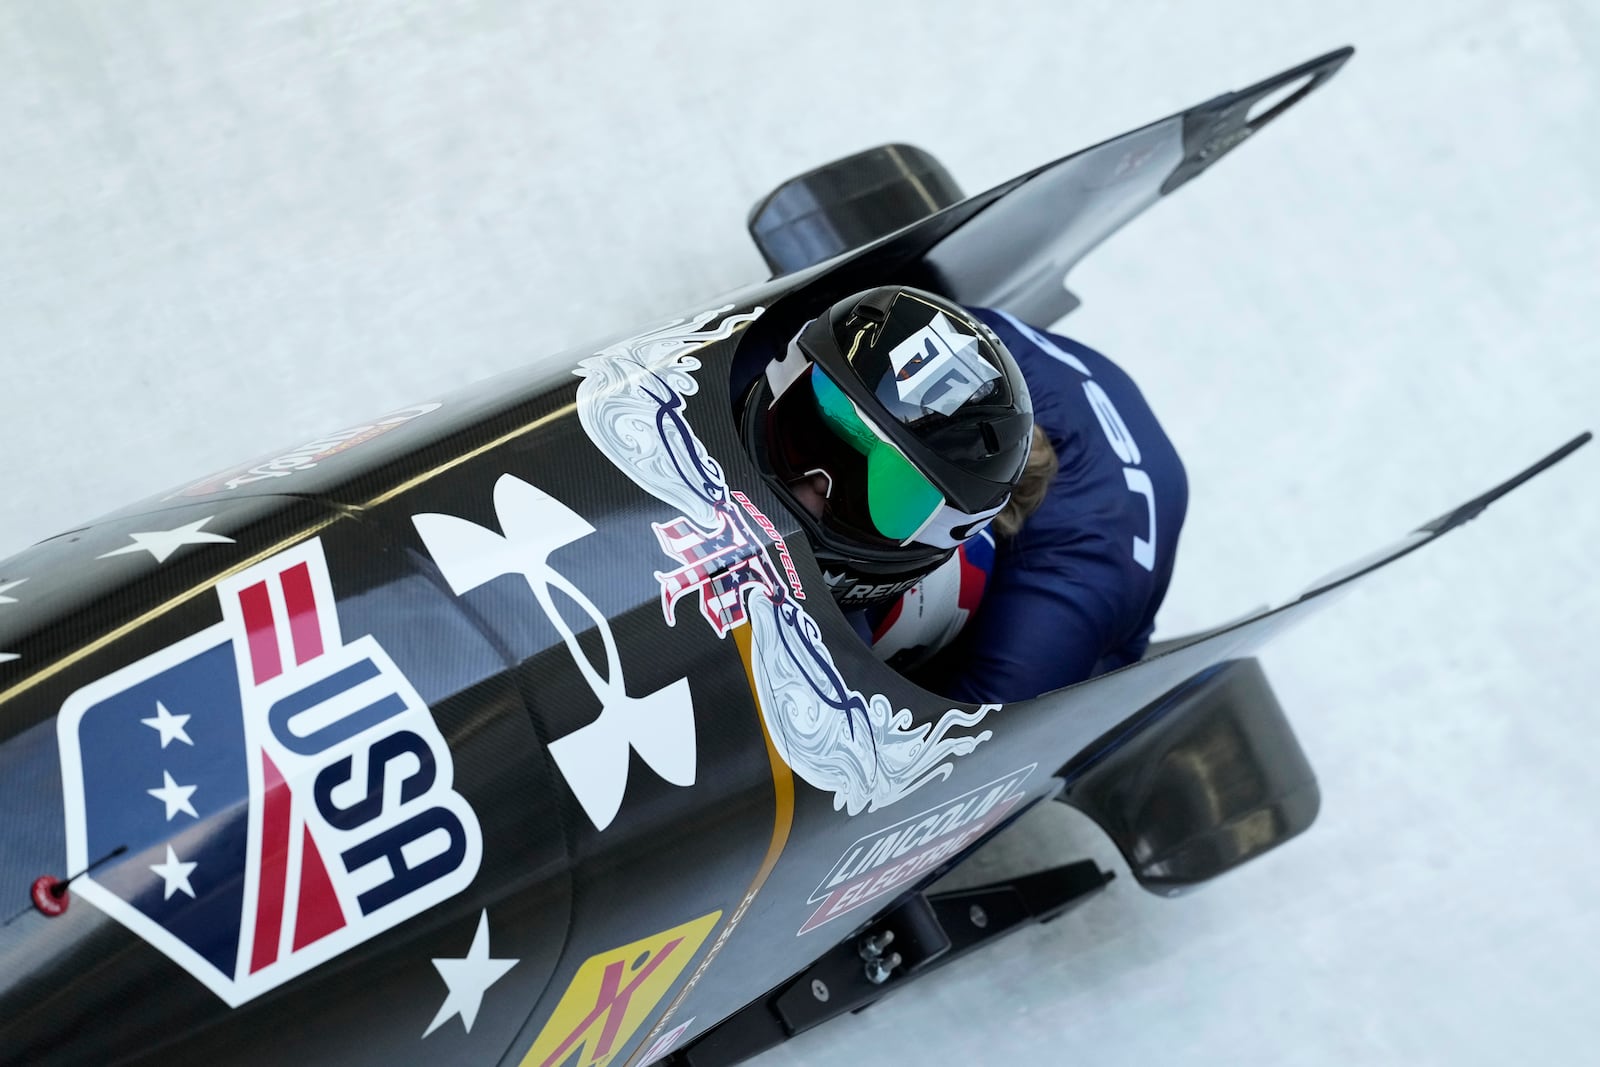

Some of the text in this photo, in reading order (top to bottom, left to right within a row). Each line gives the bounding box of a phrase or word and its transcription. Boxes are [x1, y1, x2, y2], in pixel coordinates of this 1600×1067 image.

[991, 307, 1157, 573] USA
[268, 657, 467, 917] USA
[825, 778, 1014, 890] LINCOLN
[824, 823, 985, 917] ELECTRIC
[650, 888, 758, 1038] HUMPHRIES
